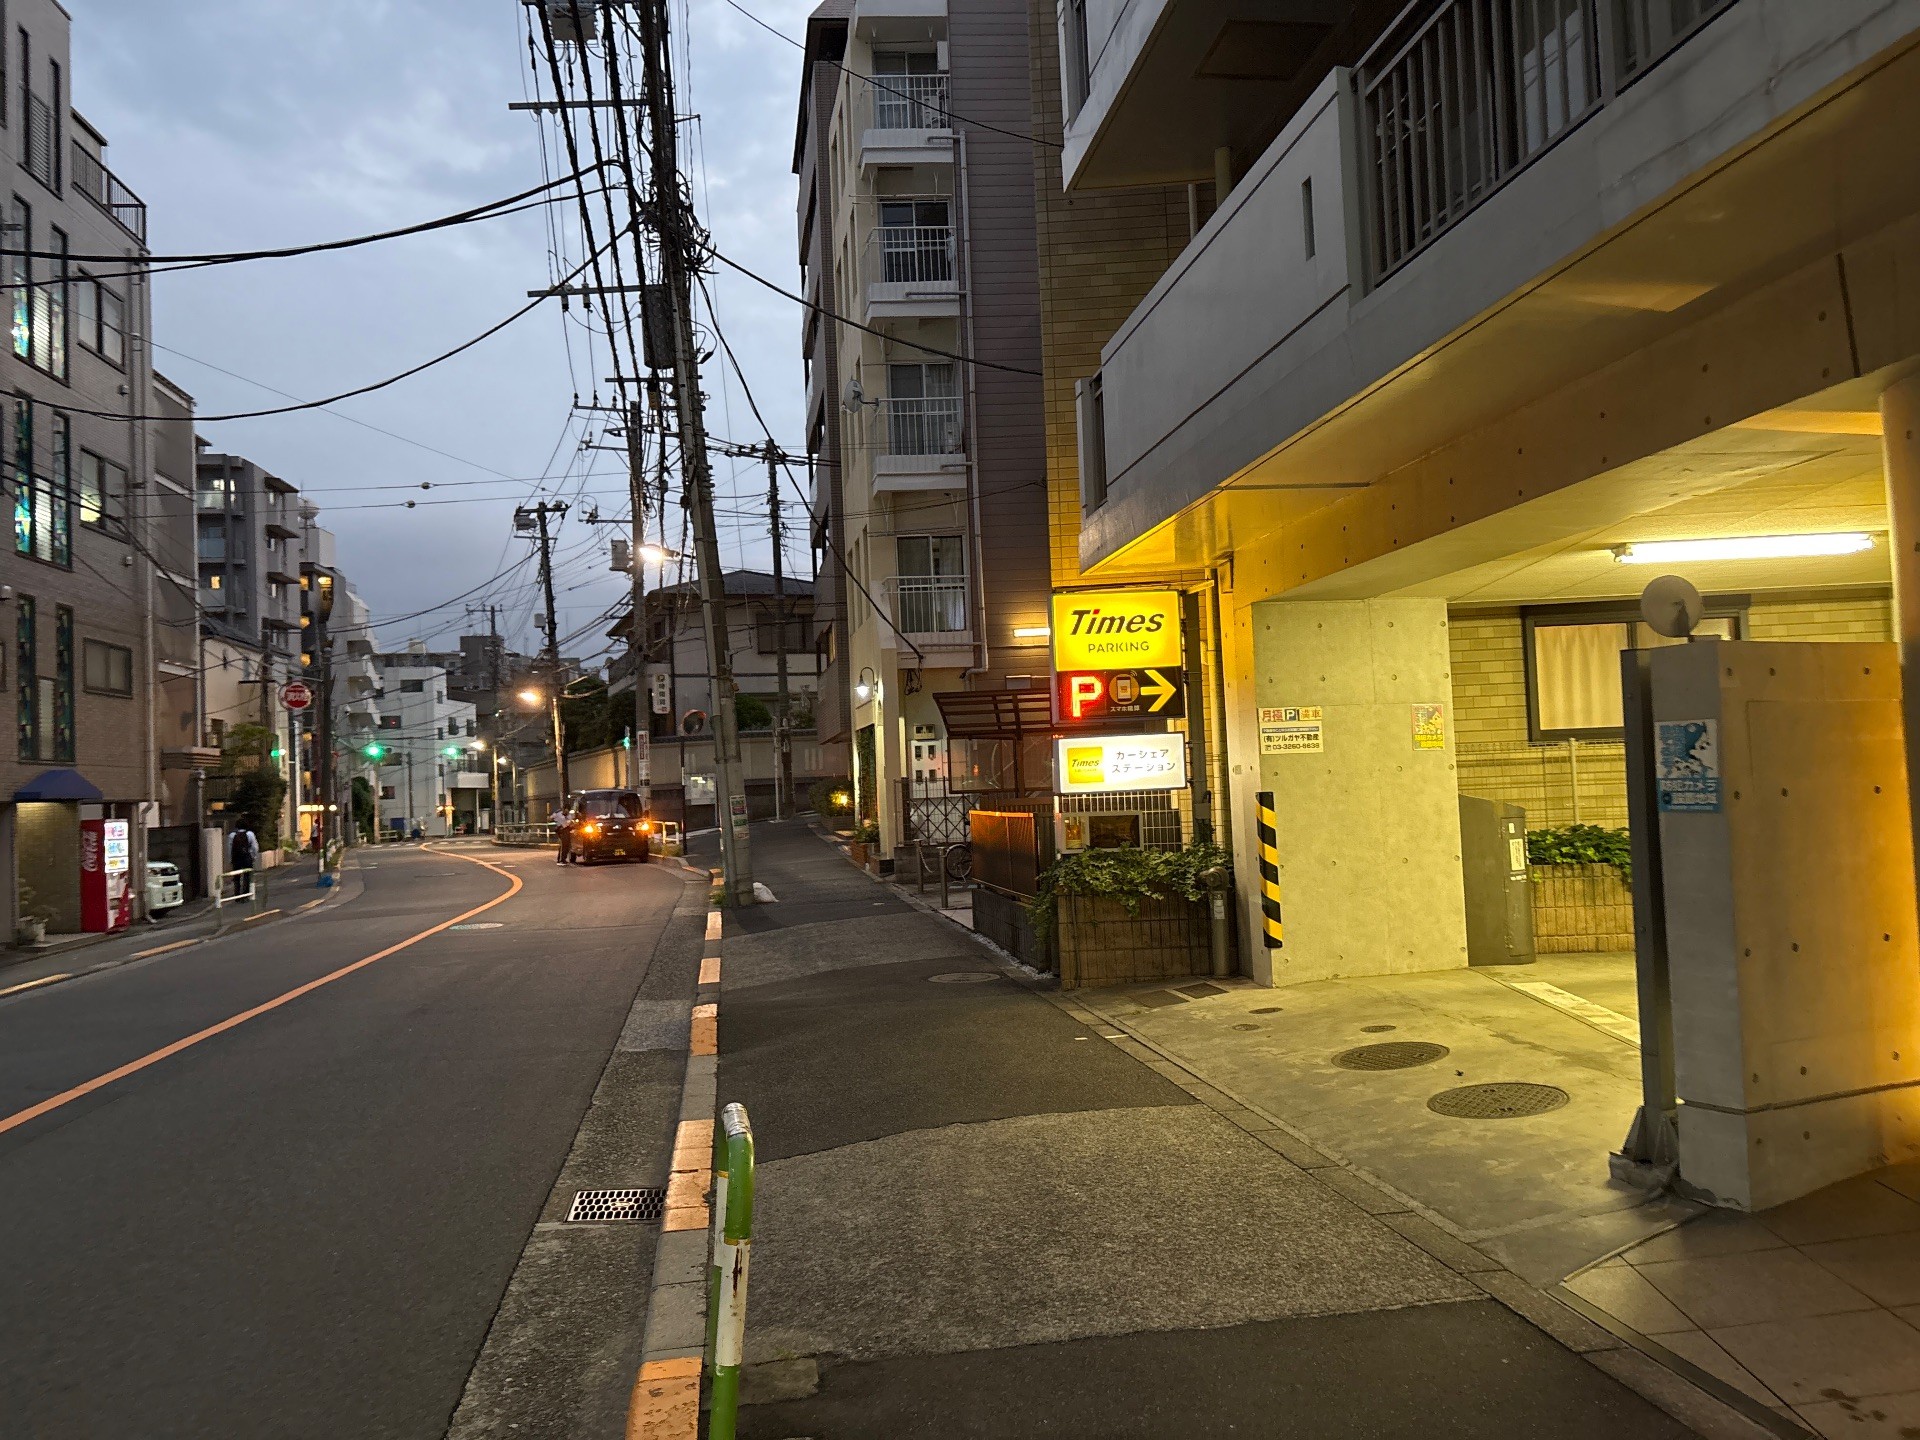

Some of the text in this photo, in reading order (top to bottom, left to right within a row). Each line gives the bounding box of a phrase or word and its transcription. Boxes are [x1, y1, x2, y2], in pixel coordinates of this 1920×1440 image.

[1070, 609, 1165, 636] Times
[1088, 641, 1150, 653] PARKING
[1071, 676, 1103, 718] P
[1116, 749, 1169, 761] カーシェア
[1071, 758, 1100, 768] Times
[1112, 762, 1176, 773] ステーション
